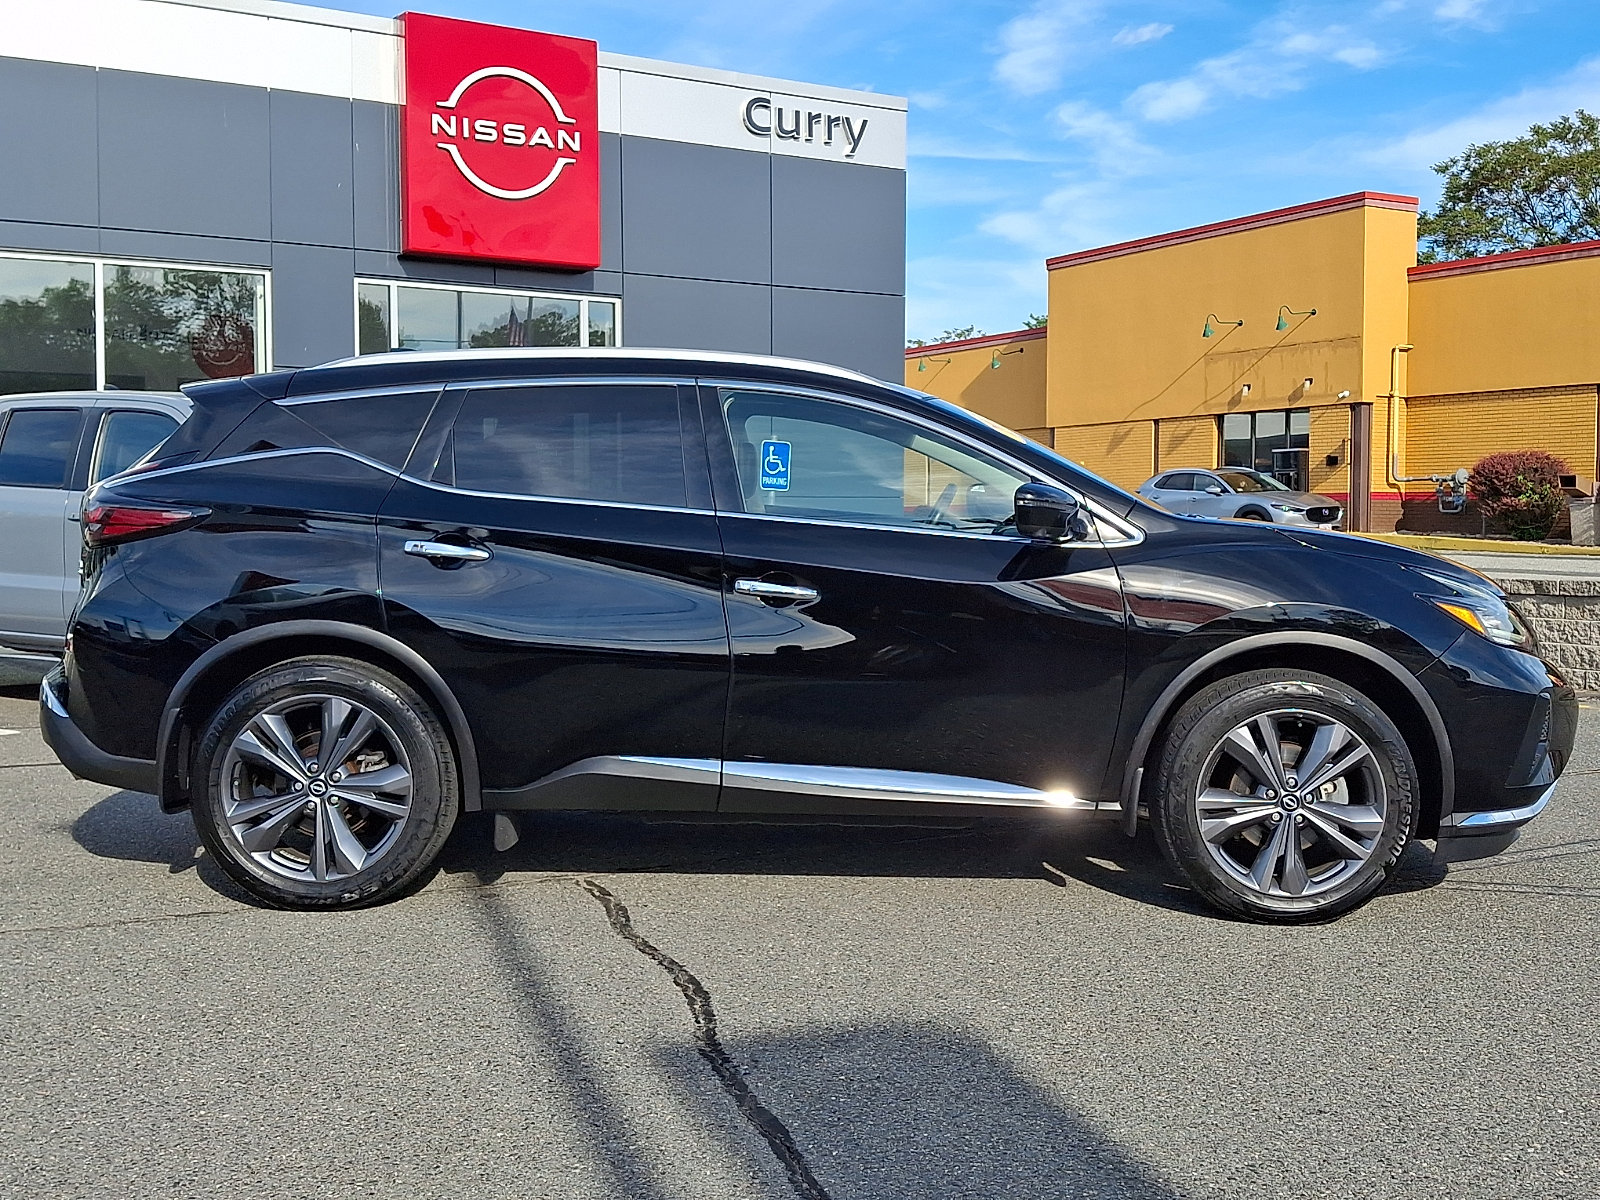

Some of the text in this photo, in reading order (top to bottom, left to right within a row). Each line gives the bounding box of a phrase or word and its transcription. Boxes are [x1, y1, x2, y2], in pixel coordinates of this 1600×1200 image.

[431, 113, 581, 153] NISSAN
[741, 97, 868, 157] Curry
[762, 476, 787, 486] PARKING
